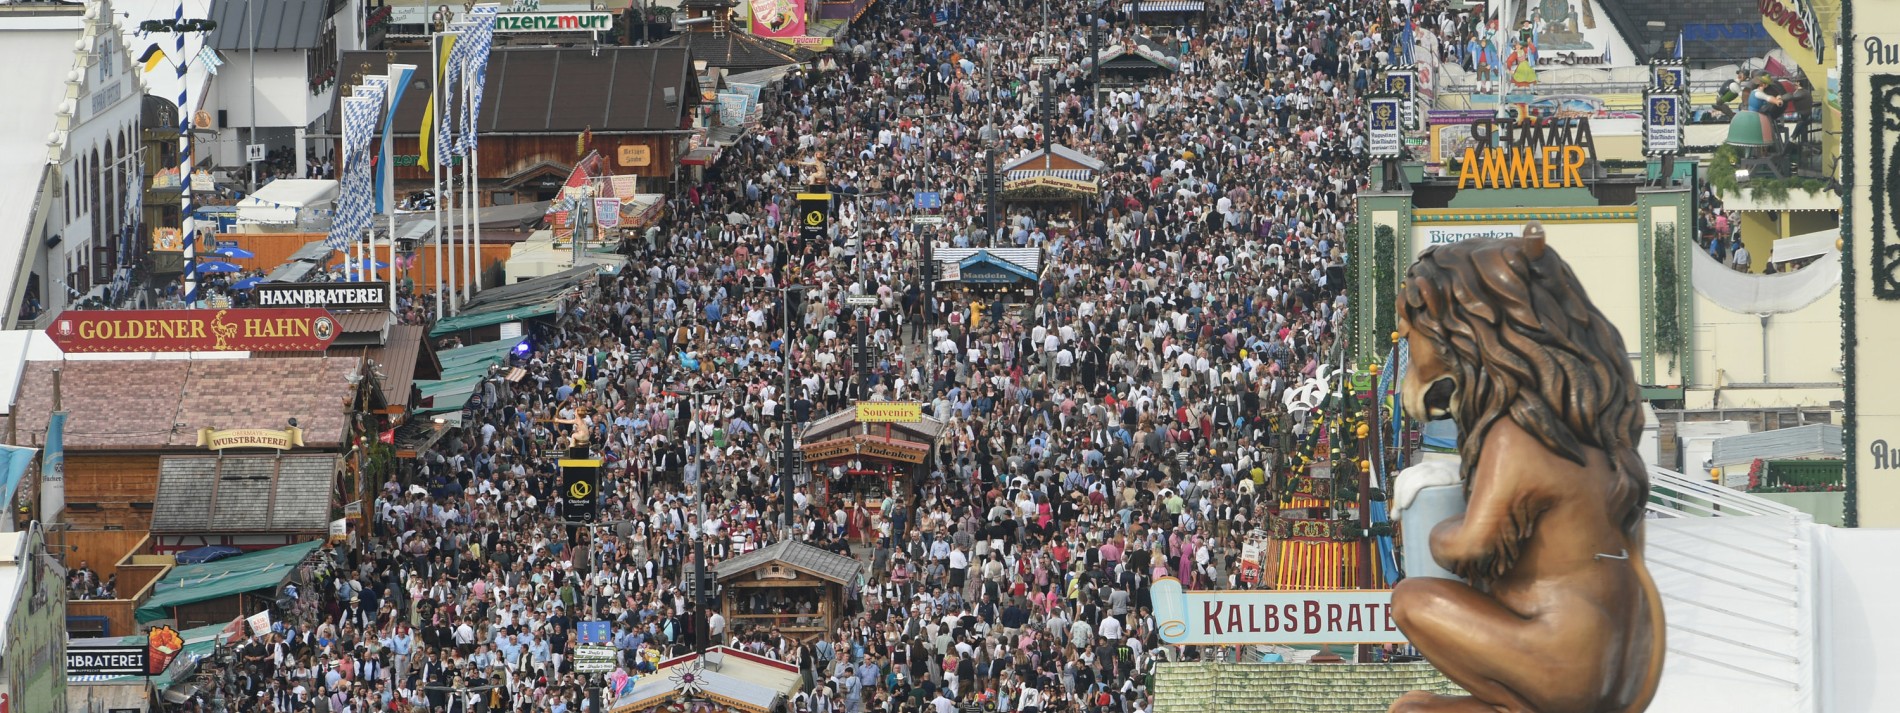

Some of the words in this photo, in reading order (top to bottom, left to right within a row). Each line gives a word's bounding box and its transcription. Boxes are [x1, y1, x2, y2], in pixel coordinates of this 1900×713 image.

[1457, 145, 1586, 190] AMMER
[260, 288, 384, 305] HAXNBRATEREI
[78, 319, 207, 340] GOLDENER
[244, 317, 310, 338] HAHN
[862, 407, 914, 418] Souvenirs
[213, 436, 288, 447] WURSTBRATEREI
[67, 654, 143, 667] HBRATEREI
